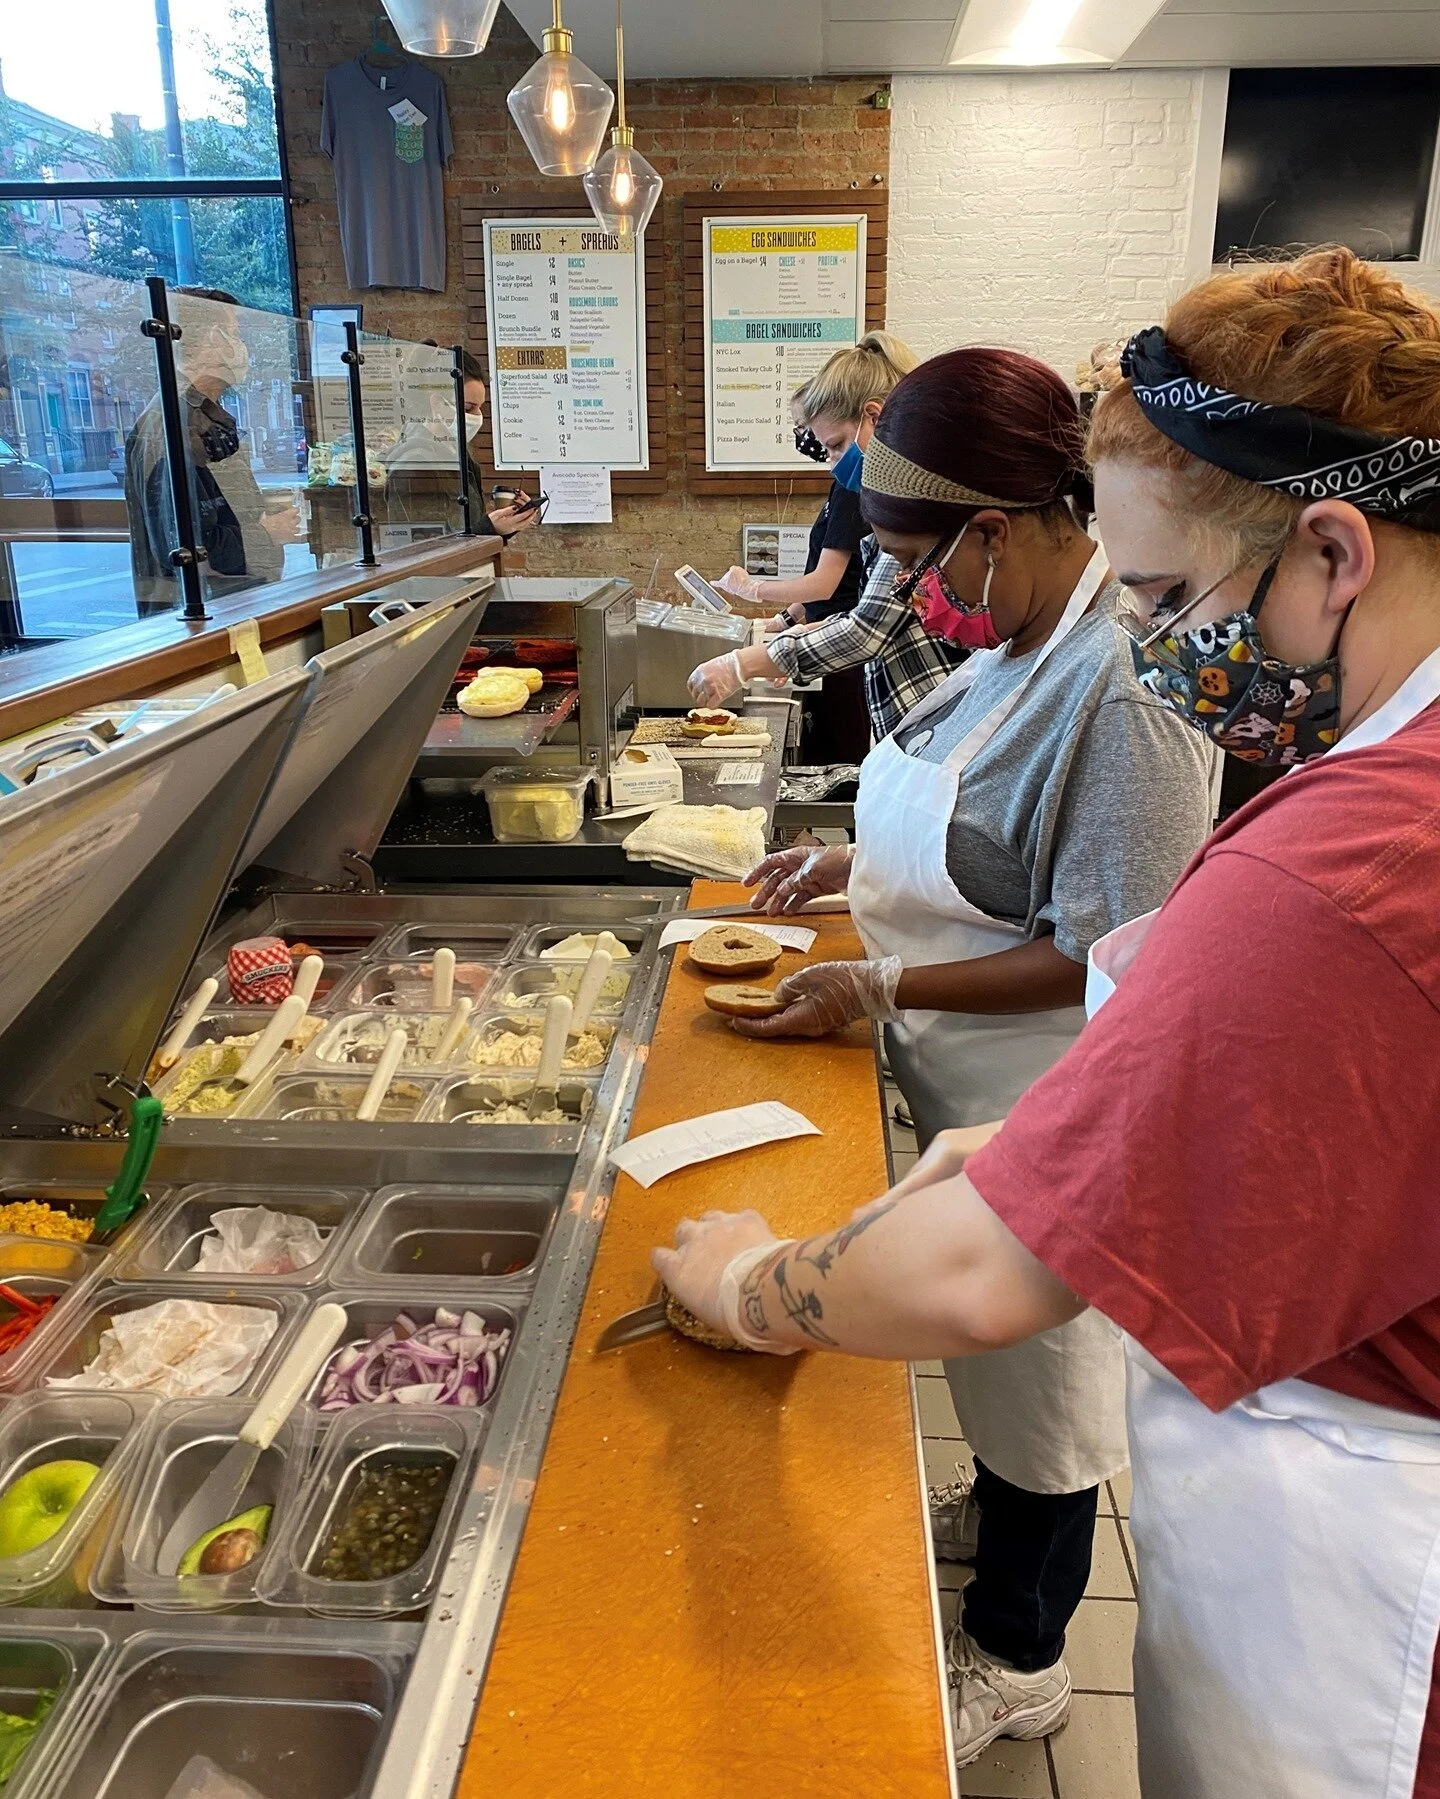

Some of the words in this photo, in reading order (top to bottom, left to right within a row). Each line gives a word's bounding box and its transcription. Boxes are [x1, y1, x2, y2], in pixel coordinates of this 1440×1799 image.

[511, 233, 541, 251] BAGELS
[581, 232, 618, 250] SPREADS
[752, 232, 765, 248] EGG
[767, 231, 816, 248] SANDWICHES
[548, 257, 556, 268] $2
[779, 256, 796, 266] CHEESE
[818, 256, 838, 266] PROTEIN
[496, 274, 514, 282] Single
[746, 323, 770, 339] BAGEL
[771, 322, 822, 338] SANDWICHES
[517, 350, 544, 366] EXTRAS
